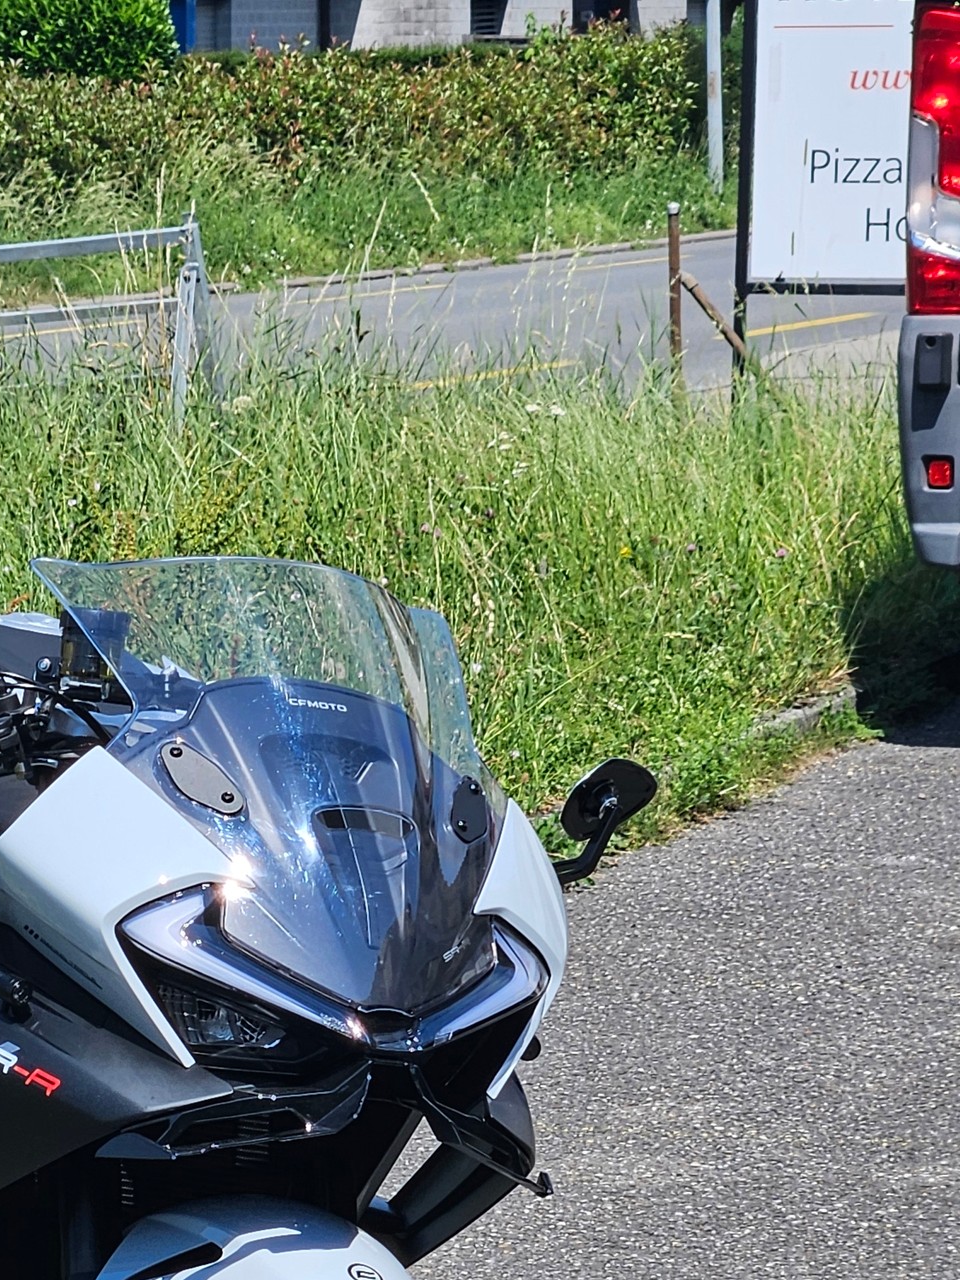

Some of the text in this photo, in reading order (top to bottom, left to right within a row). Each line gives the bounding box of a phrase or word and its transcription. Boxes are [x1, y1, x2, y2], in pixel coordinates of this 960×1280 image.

[849, 69, 911, 91] ww
[810, 147, 903, 184] Pizza
[288, 698, 348, 712] CFMOTO
